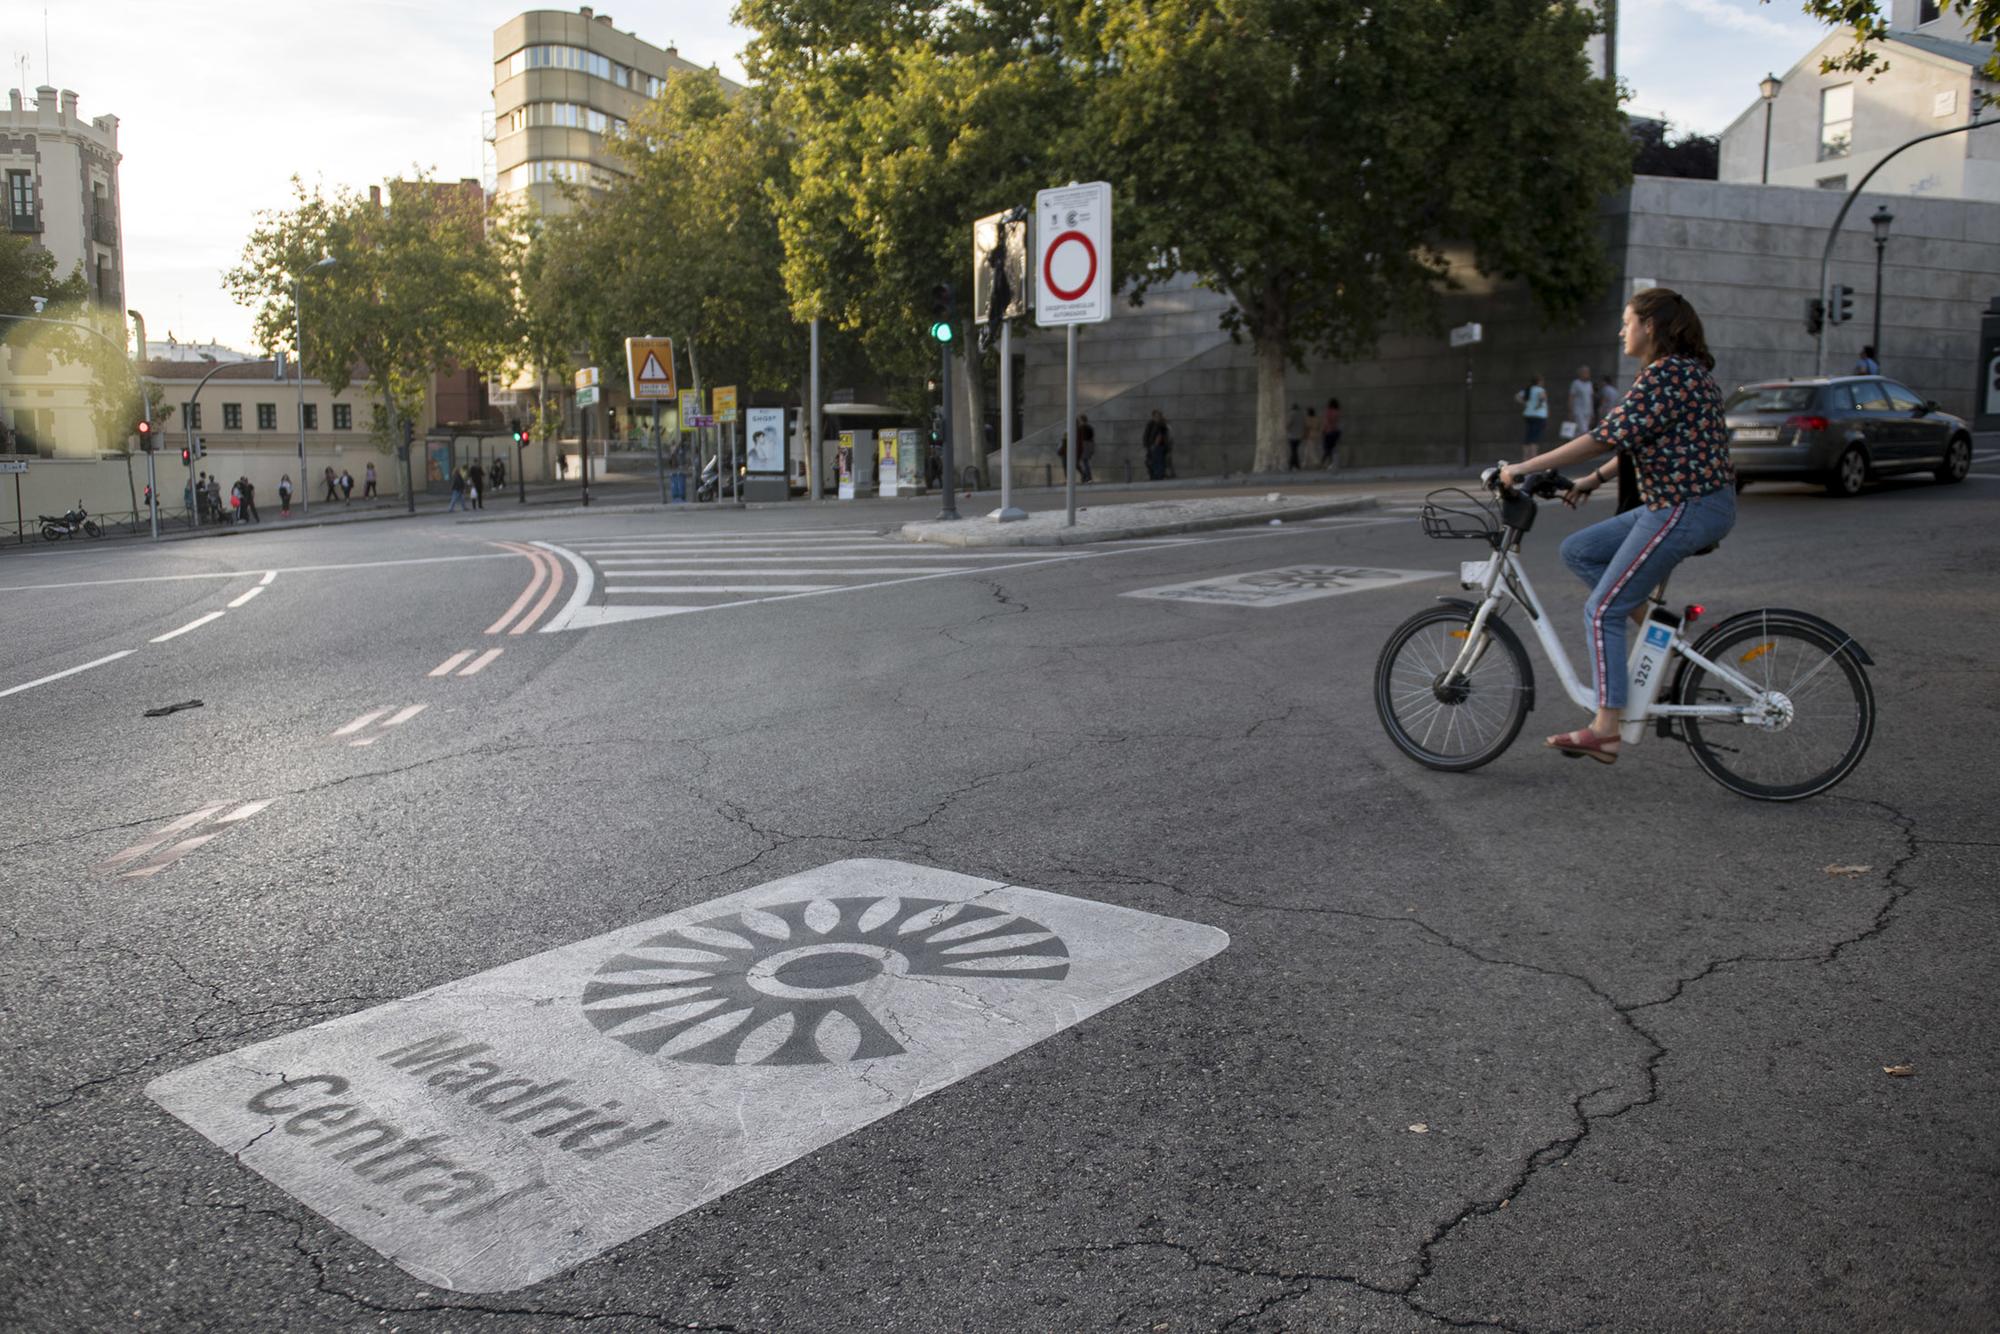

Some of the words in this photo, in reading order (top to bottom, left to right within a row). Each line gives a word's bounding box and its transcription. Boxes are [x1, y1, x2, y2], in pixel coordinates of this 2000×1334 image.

[1634, 655, 1654, 687] 3257
[246, 1074, 549, 1226] Central
[377, 1031, 673, 1161] Madrid
